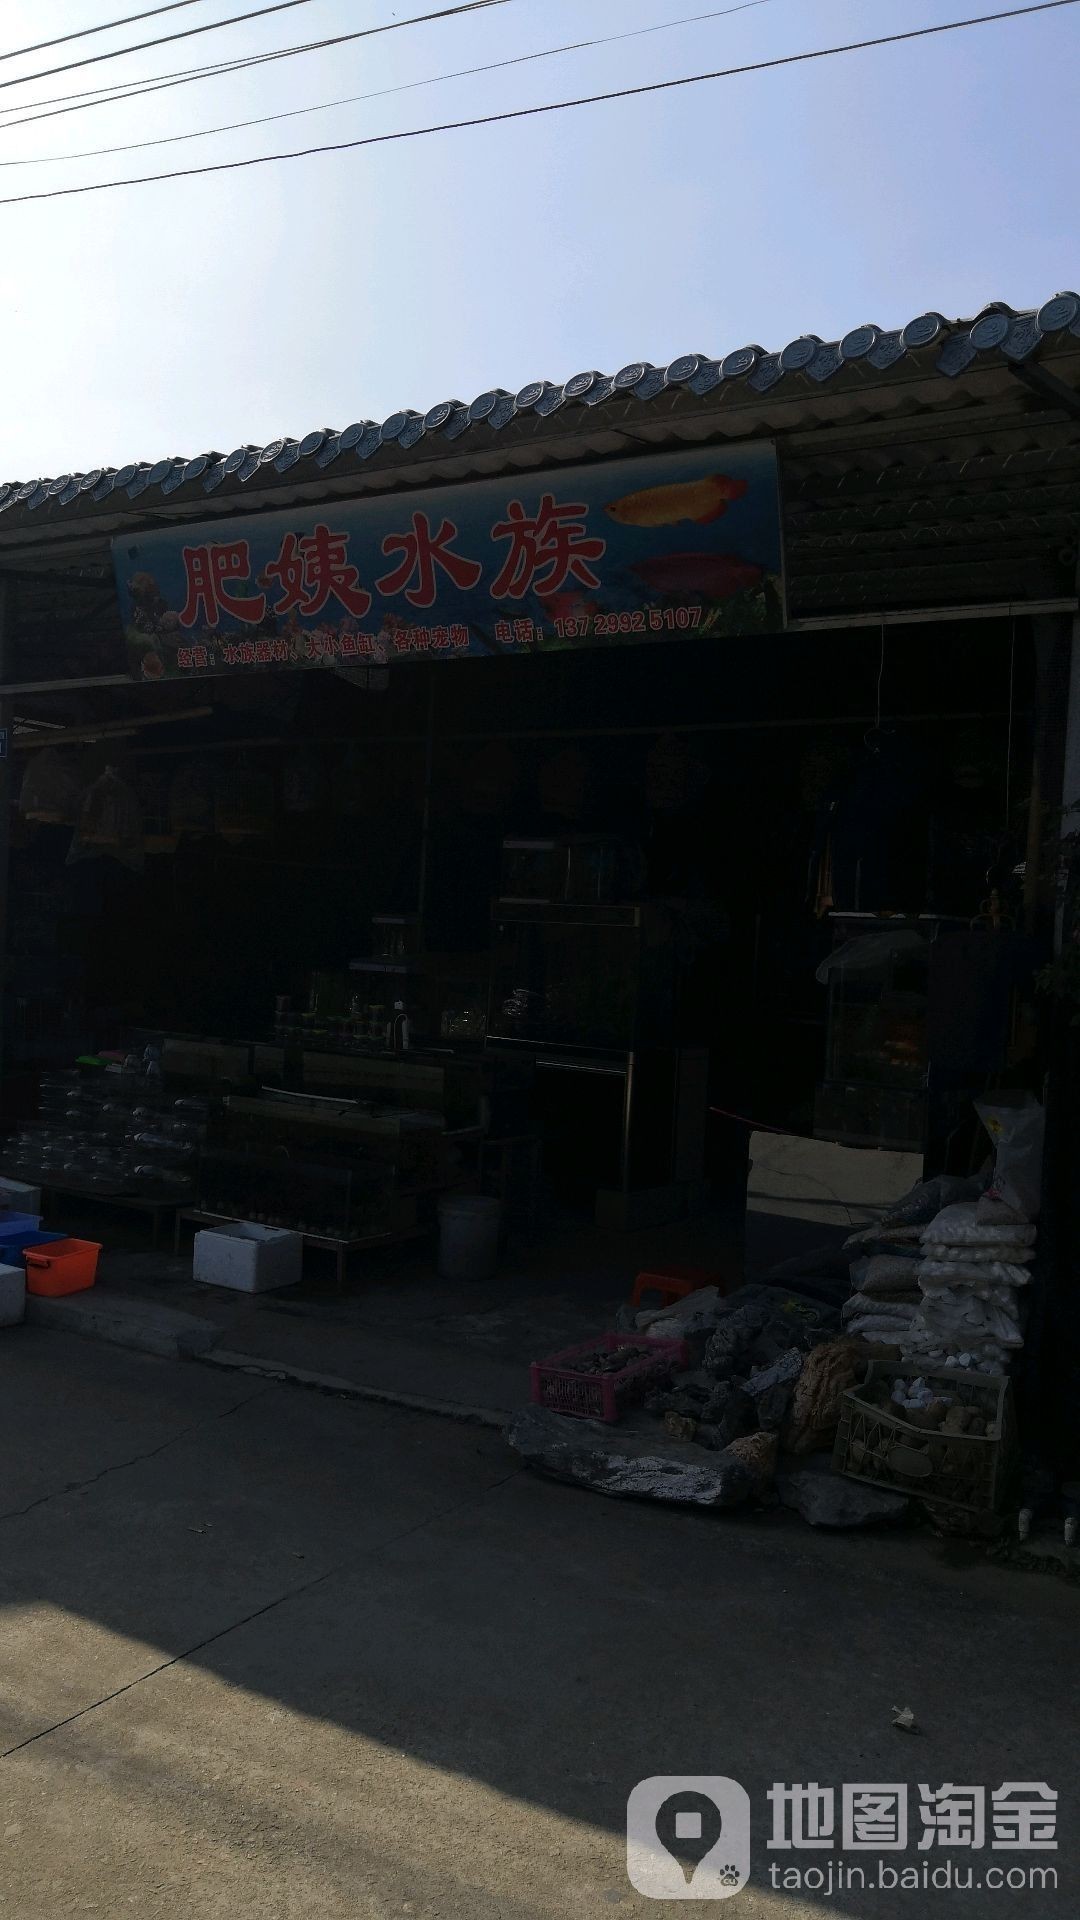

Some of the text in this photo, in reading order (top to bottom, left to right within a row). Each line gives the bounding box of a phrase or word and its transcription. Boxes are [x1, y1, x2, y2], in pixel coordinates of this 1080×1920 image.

[178, 493, 607, 628] 肥姨水族
[554, 616, 589, 638] 137
[594, 610, 646, 635] 2992
[649, 606, 702, 631] 5107
